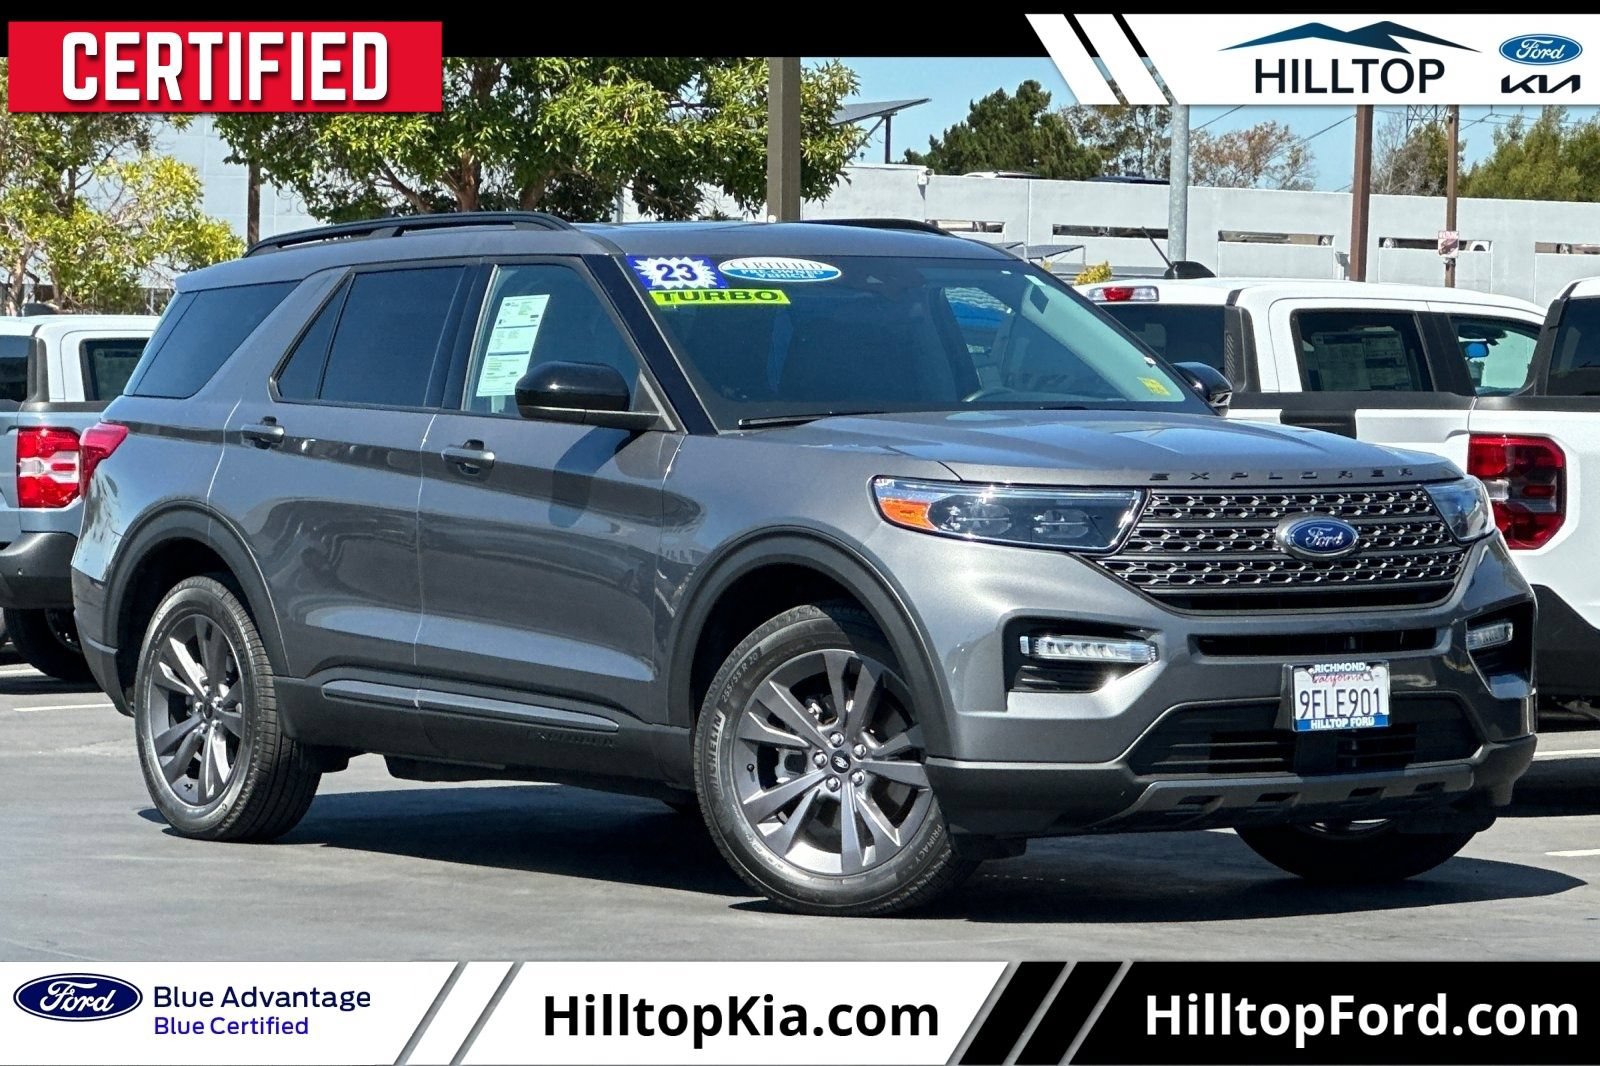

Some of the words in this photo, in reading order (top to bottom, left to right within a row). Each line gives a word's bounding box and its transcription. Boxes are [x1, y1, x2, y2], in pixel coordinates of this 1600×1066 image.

[729, 260, 823, 270] CERTIFIED
[655, 263, 698, 282] 23
[656, 290, 779, 301] TURBO
[1149, 467, 1413, 481] EXPLORER
[1305, 526, 1344, 547] Ford
[1314, 662, 1366, 673] RICHMOND
[1299, 687, 1383, 719] 9FLE901
[1310, 718, 1348, 729] HILLTOP
[1350, 716, 1375, 727] FORD
[915, 823, 943, 864] PRIMACY
